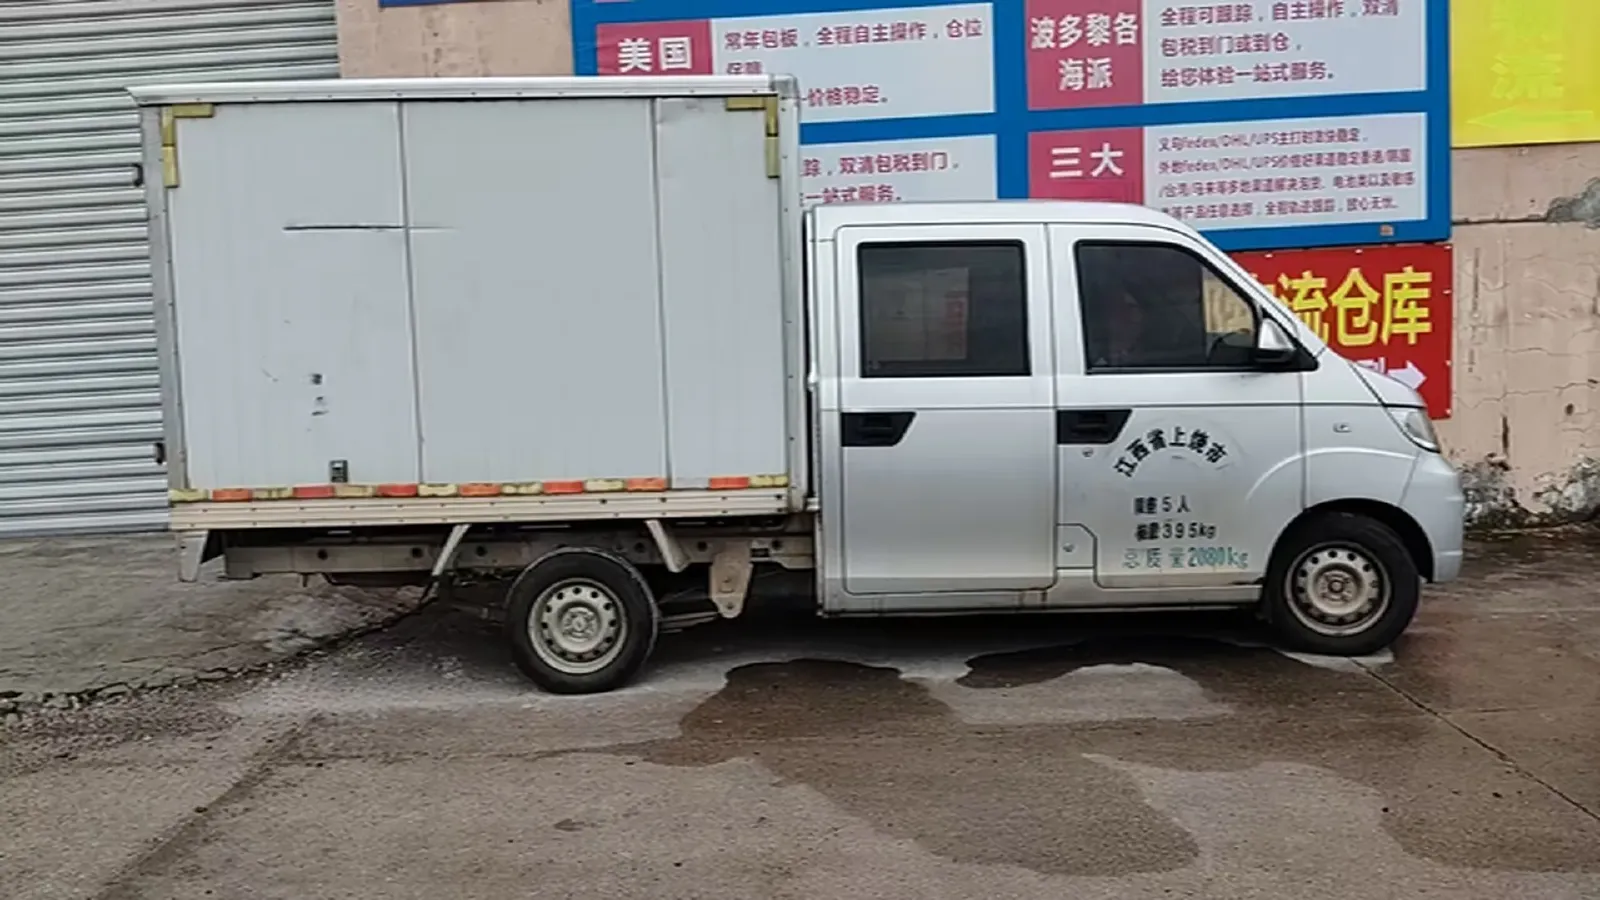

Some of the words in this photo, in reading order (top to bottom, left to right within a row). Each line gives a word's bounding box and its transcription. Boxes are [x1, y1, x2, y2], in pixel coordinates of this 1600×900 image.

[1031, 13, 1138, 48] 波多黎各
[619, 36, 692, 73] 美国
[1059, 58, 1113, 91] 海派
[804, 85, 887, 106] 价格稳定。
[1050, 142, 1124, 177] 三大
[1268, 266, 1432, 346] 流仓库
[1113, 426, 1227, 477] 江西省上饶市
